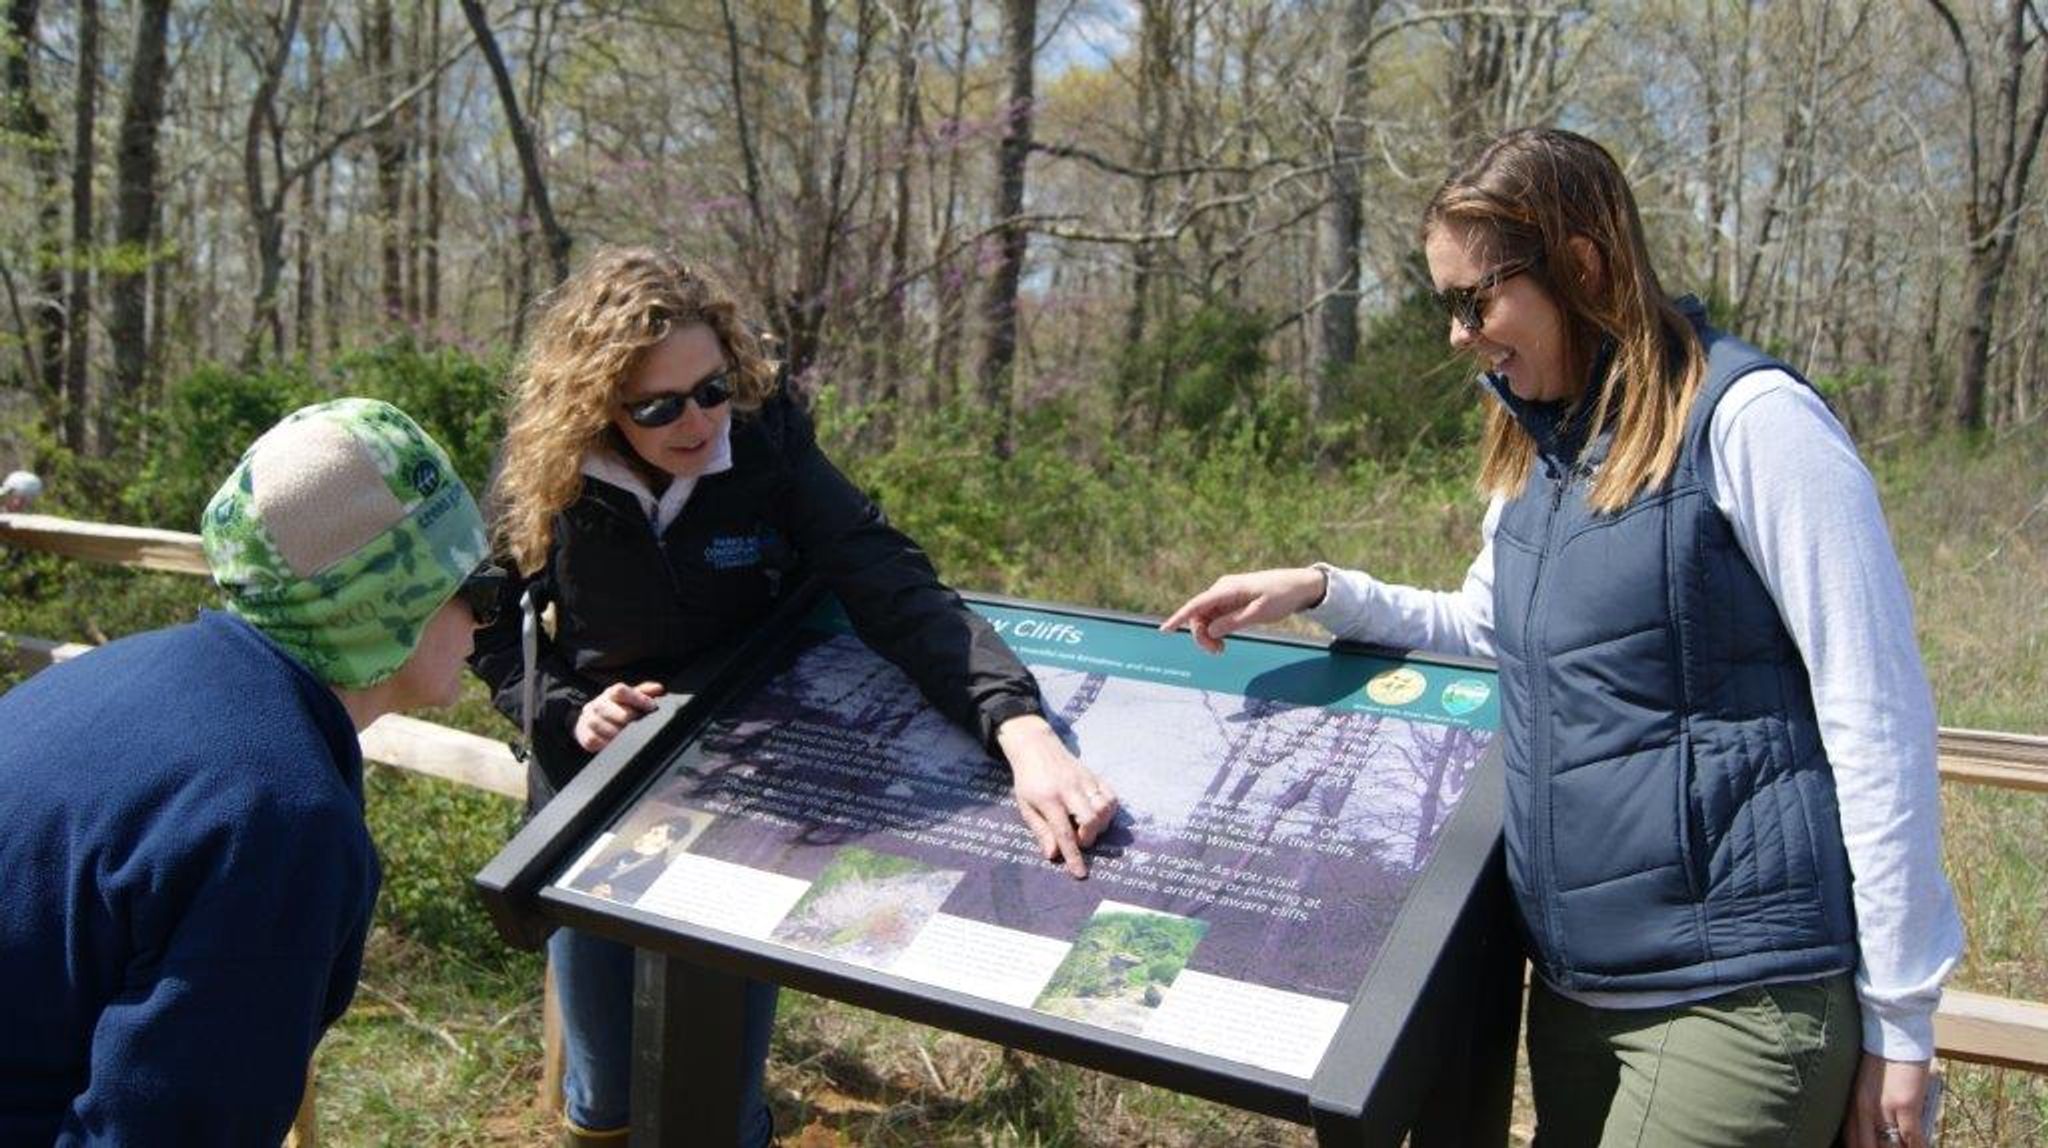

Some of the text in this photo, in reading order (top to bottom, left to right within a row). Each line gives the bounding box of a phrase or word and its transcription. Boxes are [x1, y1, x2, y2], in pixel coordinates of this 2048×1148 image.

[1014, 619, 1083, 645] Cliffs
[949, 836, 991, 857] safety
[1011, 853, 1038, 868] you
[1314, 840, 1355, 859] cliffs
[1096, 867, 1122, 883] the
[1162, 881, 1195, 898] and
[1194, 888, 1216, 904] be
[1218, 894, 1268, 915] aware
[1129, 860, 1157, 876] not
[1157, 864, 1223, 892] climbing
[1225, 880, 1242, 892] or
[1244, 882, 1301, 908] picking
[1303, 896, 1323, 910] at
[1232, 868, 1262, 885] you
